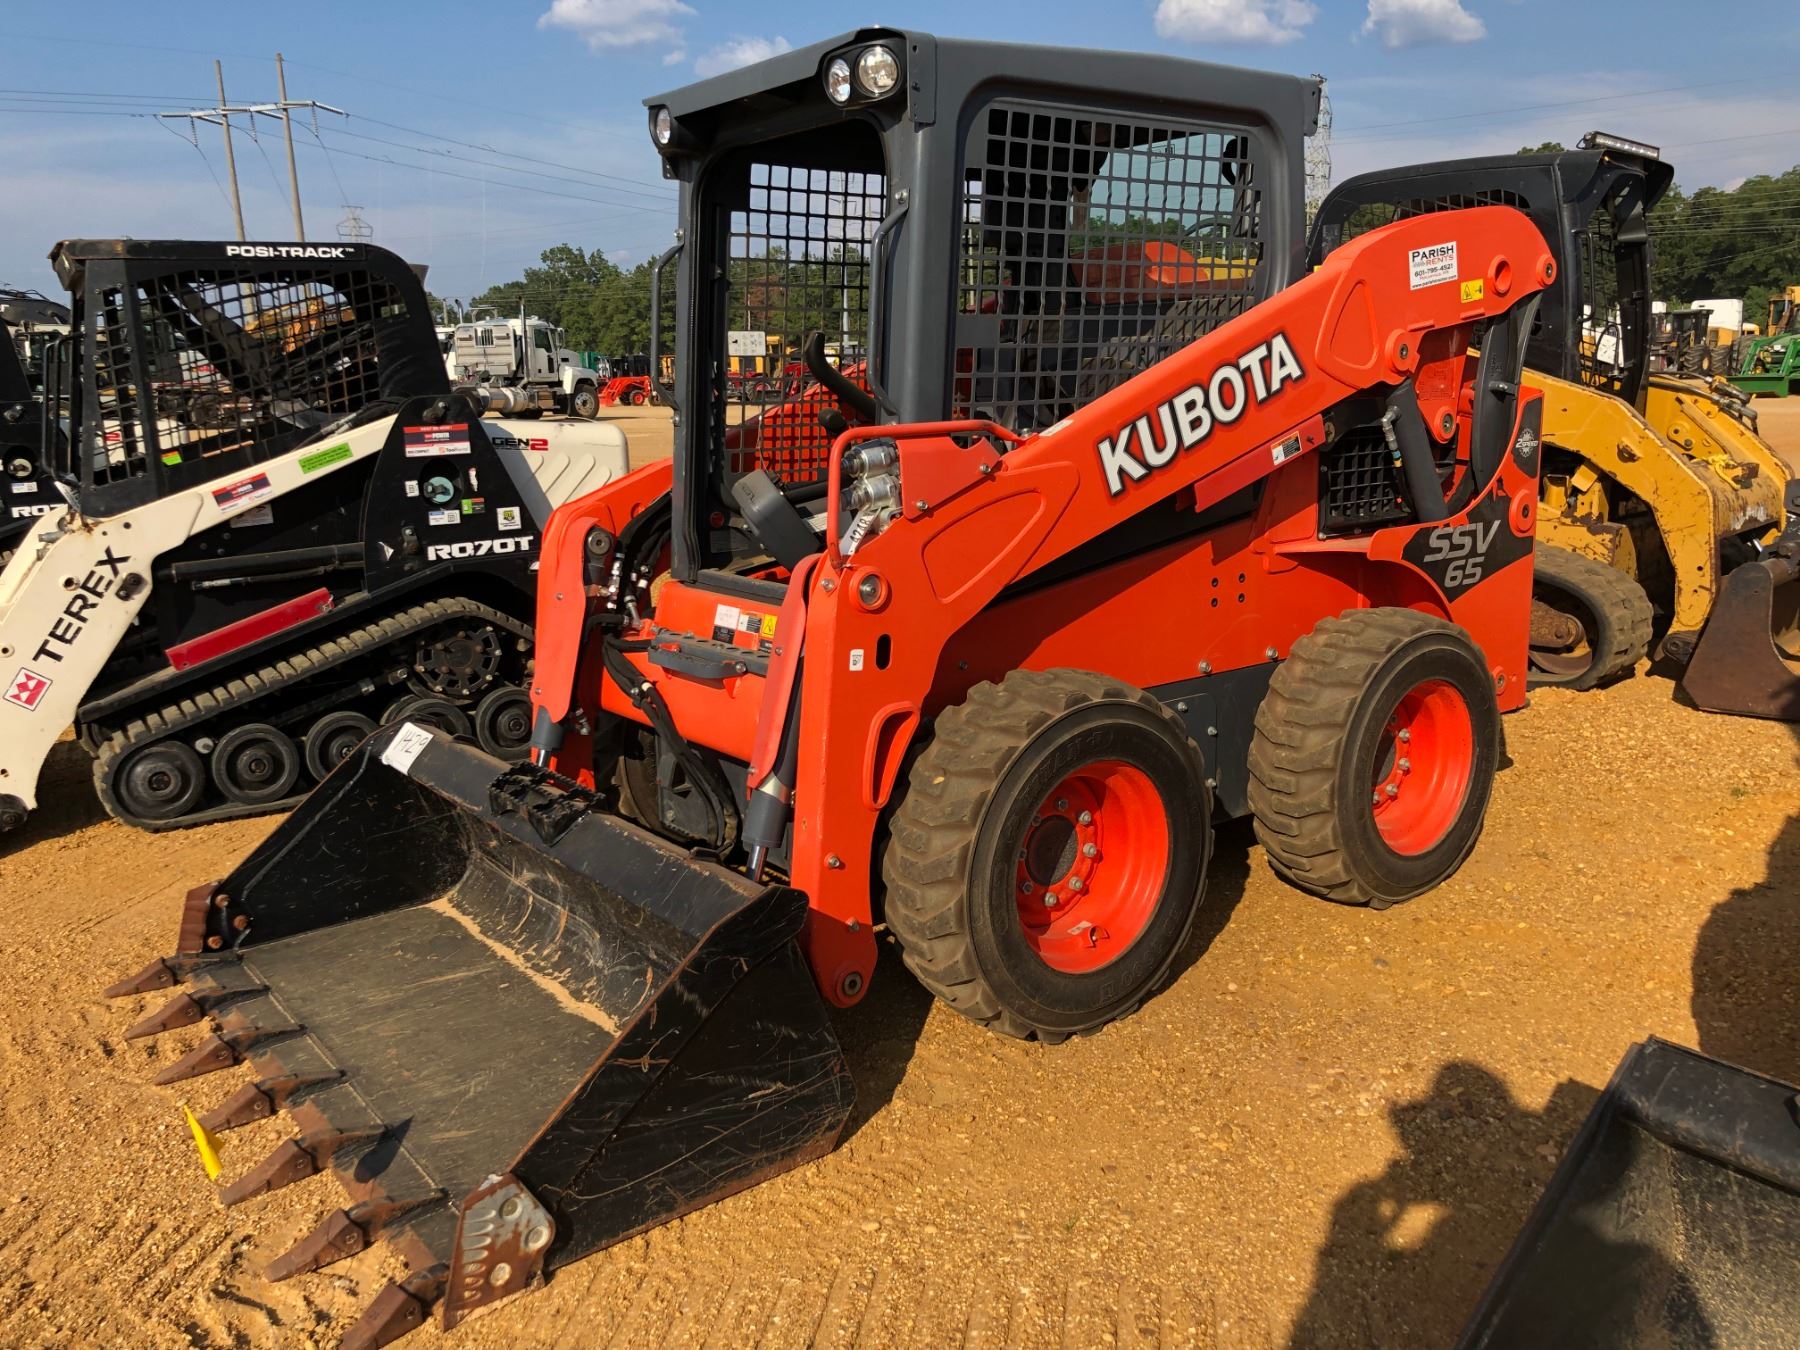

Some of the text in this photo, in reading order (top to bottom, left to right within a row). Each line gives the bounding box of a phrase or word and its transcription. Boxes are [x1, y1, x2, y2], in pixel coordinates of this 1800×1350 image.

[1412, 244, 1454, 262] PARISH
[1425, 255, 1454, 266] RENTS
[1097, 332, 1304, 497] KUBOTA
[1423, 519, 1502, 563] SSV
[1444, 556, 1485, 588] 65
[32, 545, 132, 662] TEREX
